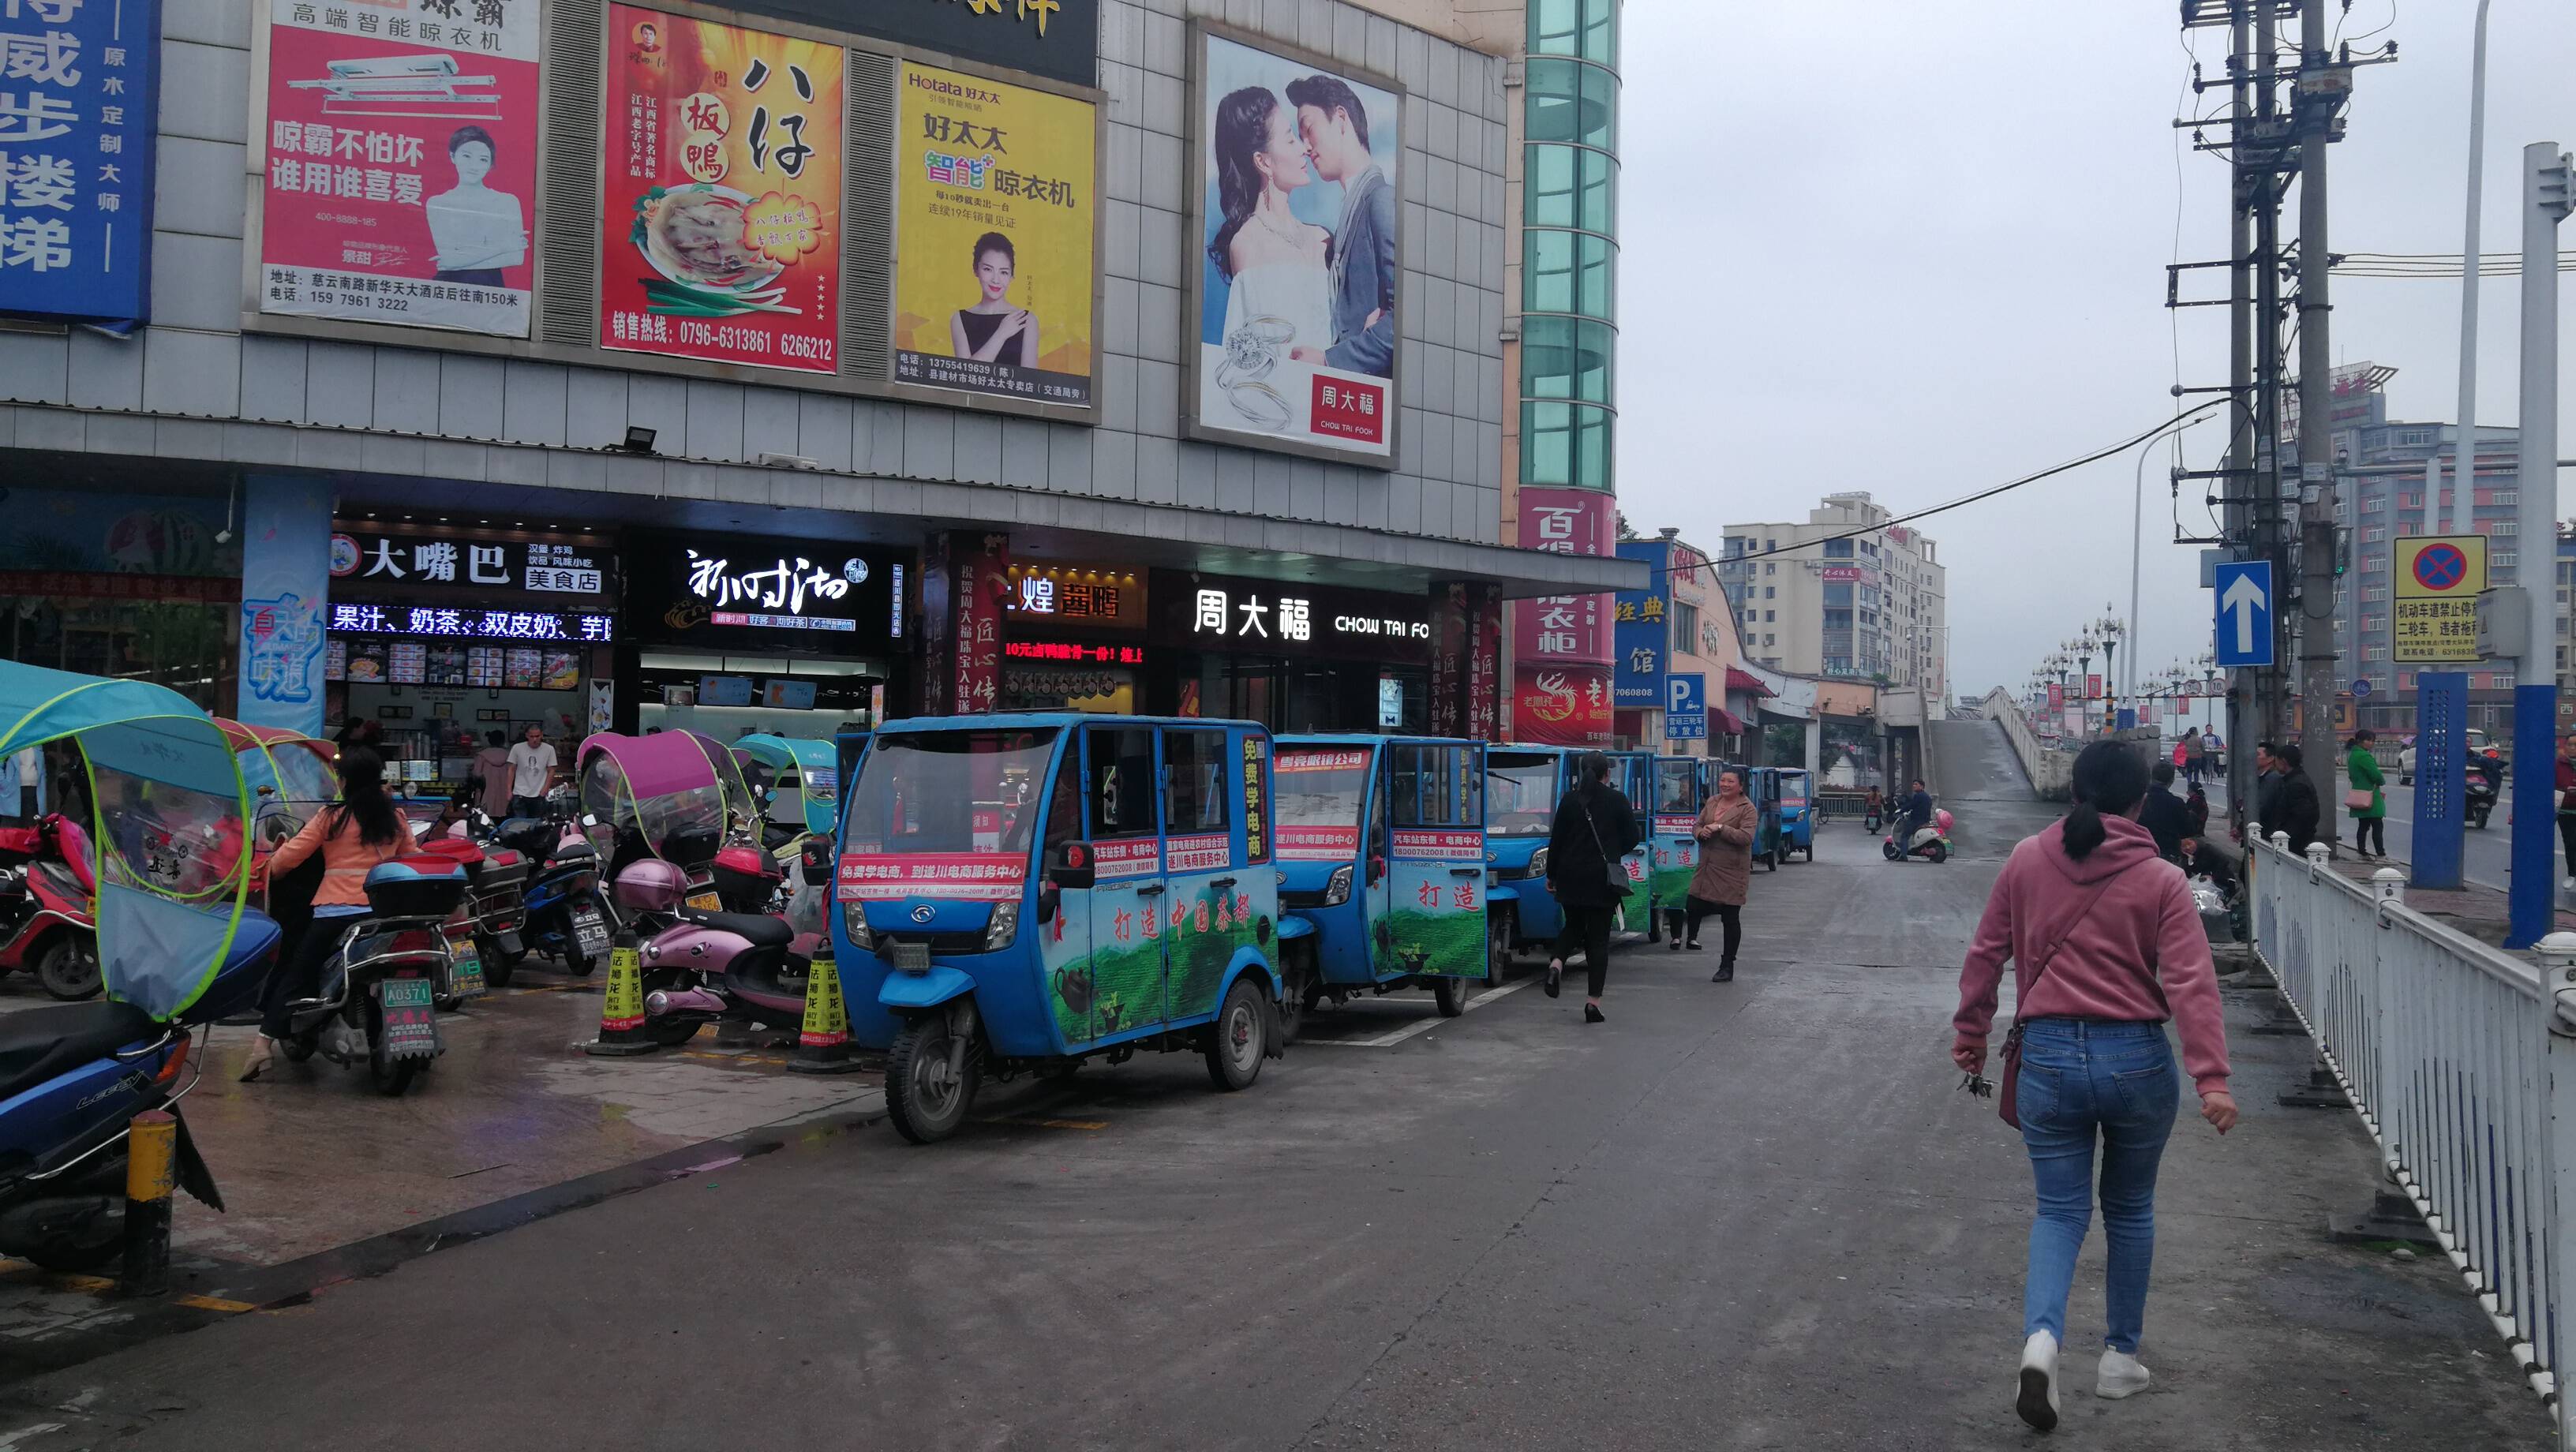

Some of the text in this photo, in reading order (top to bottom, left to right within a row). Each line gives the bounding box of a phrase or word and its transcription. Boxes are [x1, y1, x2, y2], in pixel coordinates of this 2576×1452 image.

[293, 3, 502, 51] 高端智能晾衣机
[909, 73, 1001, 105] Hotata 好太太
[98, 47, 126, 212] 原木定制大师
[630, 93, 643, 178] 江西老字号产品
[644, 96, 657, 179] 江西省著名商标
[923, 113, 1008, 155] 好太太
[273, 120, 424, 168] 晾霸不怕坏
[271, 157, 423, 207] 谁用谁喜爱
[994, 168, 1075, 208] 晾衣机
[936, 190, 1010, 213] 每10秒就卖出一台
[316, 211, 377, 227] 400-8888-185
[928, 203, 1017, 230] 连续19年销量见证
[342, 249, 372, 266] 景甜
[341, 294, 370, 308] 7961
[377, 298, 409, 312] 3222
[781, 333, 832, 361] 6266212
[1321, 385, 1374, 416] 周大福
[1320, 420, 1373, 436] CHOW TAI FOOK
[362, 538, 511, 584] 大嘴巴
[528, 543, 574, 556] 汉堡 炸鸡
[528, 555, 593, 568] 饮品 风味小吃
[528, 569, 598, 591] 美食店
[1194, 589, 1310, 641] 周大福
[1335, 615, 1429, 638] CHOW TAI FO
[974, 618, 998, 714] 匠心传
[1630, 646, 1657, 673] 馆
[1671, 679, 1690, 712] P
[1668, 717, 1703, 726] 营运三轮车
[1668, 725, 1704, 736] 停放位
[1244, 739, 1260, 858] 免费学电商
[1394, 834, 1481, 846] 汽车站东侧·电商中心
[841, 863, 1022, 881] 免费学电商，到遂川电商服务中心
[1168, 851, 1228, 869] 遂川电商服务中心
[1624, 857, 1646, 882] 造
[1655, 848, 1695, 869] 打造
[1418, 880, 1480, 912] 打造
[1114, 891, 1250, 941] 打造中国茶都
[577, 926, 608, 943] 立马
[388, 988, 426, 1001] A0371
